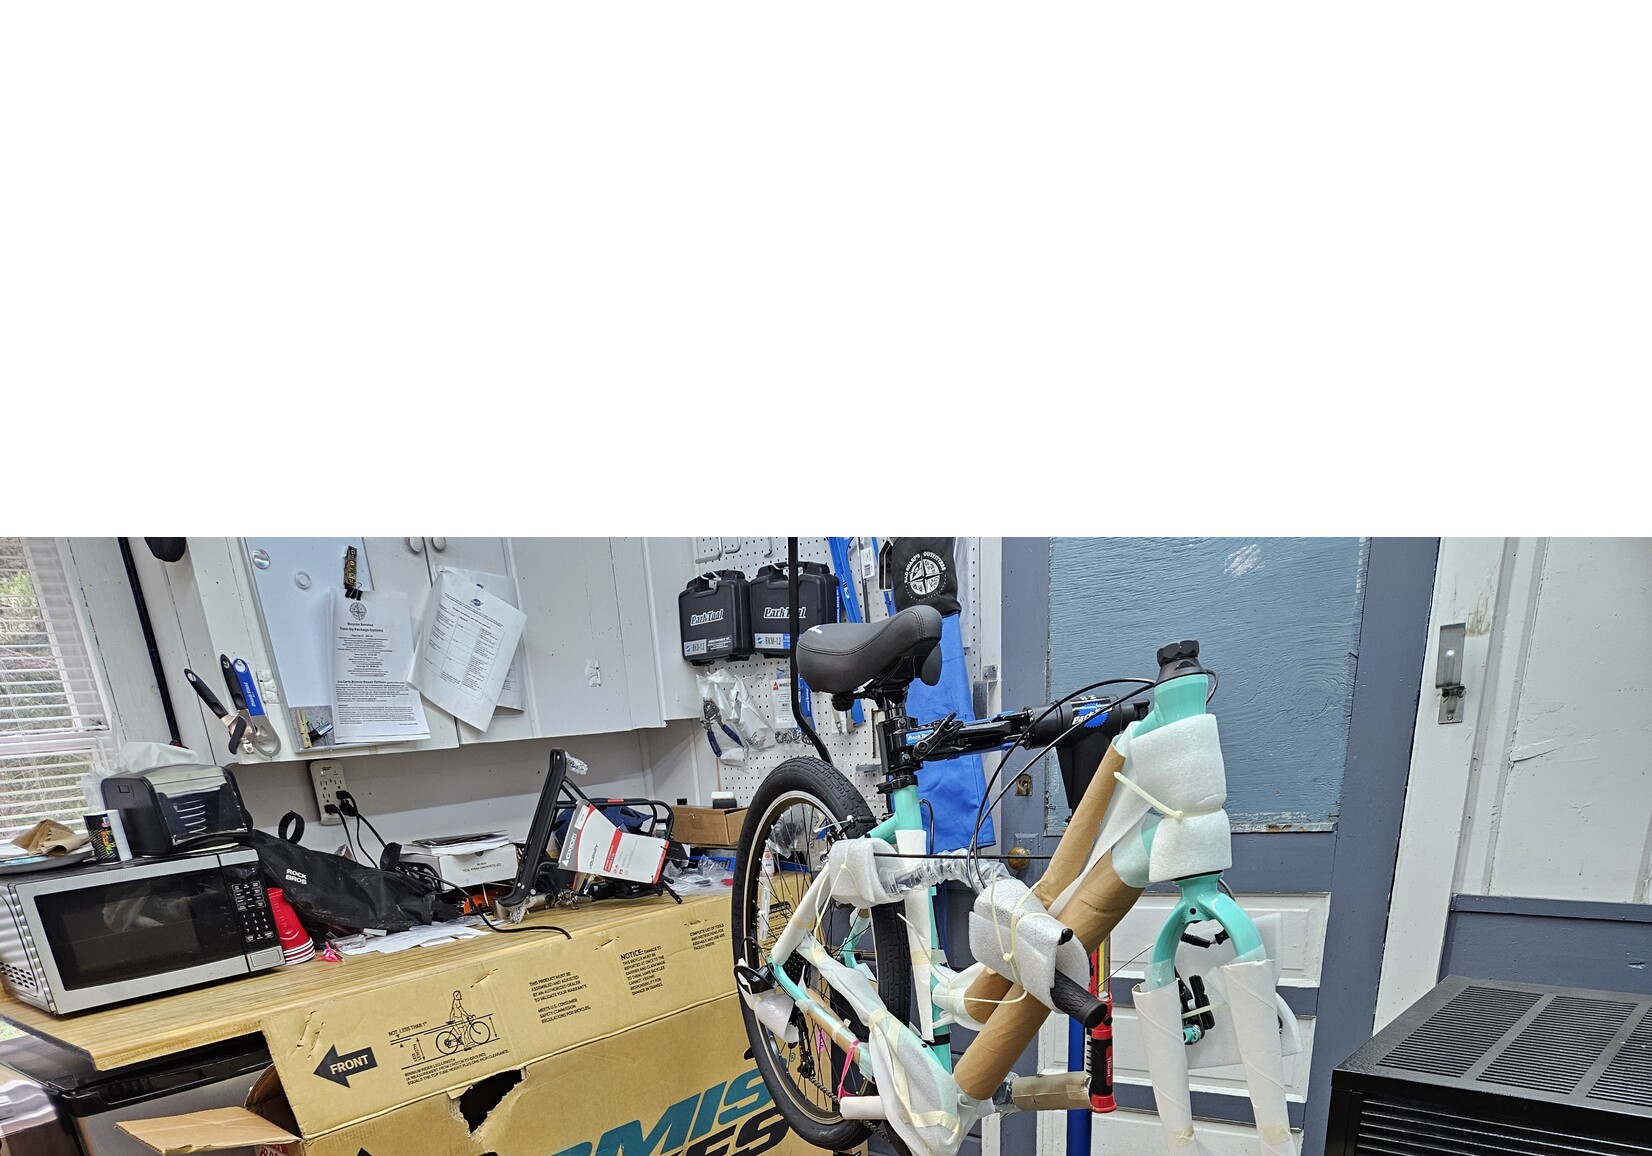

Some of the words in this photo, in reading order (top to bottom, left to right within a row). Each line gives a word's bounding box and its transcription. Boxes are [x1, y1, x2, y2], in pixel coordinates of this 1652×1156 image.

[923, 551, 947, 571] OUTFITTERS
[690, 612, 709, 627] Park
[708, 609, 724, 622] Tool
[763, 607, 783, 619] Park
[783, 607, 807, 618] Tol
[566, 832, 578, 860] axiom
[589, 843, 599, 870] JOURNEY
[285, 874, 308, 885] BROS
[286, 868, 307, 880] ROCK
[620, 949, 643, 960] NOTICE:
[531, 983, 552, 991] ASSEMBLED
[544, 985, 566, 993] AUTHORIZED
[557, 998, 577, 1006] CONSUMER
[553, 1005, 576, 1013] COMMISSION
[541, 1013, 566, 1023] REGULATIONS
[330, 1055, 369, 1075] FRONT
[411, 1069, 437, 1079] MEASUREMENT
